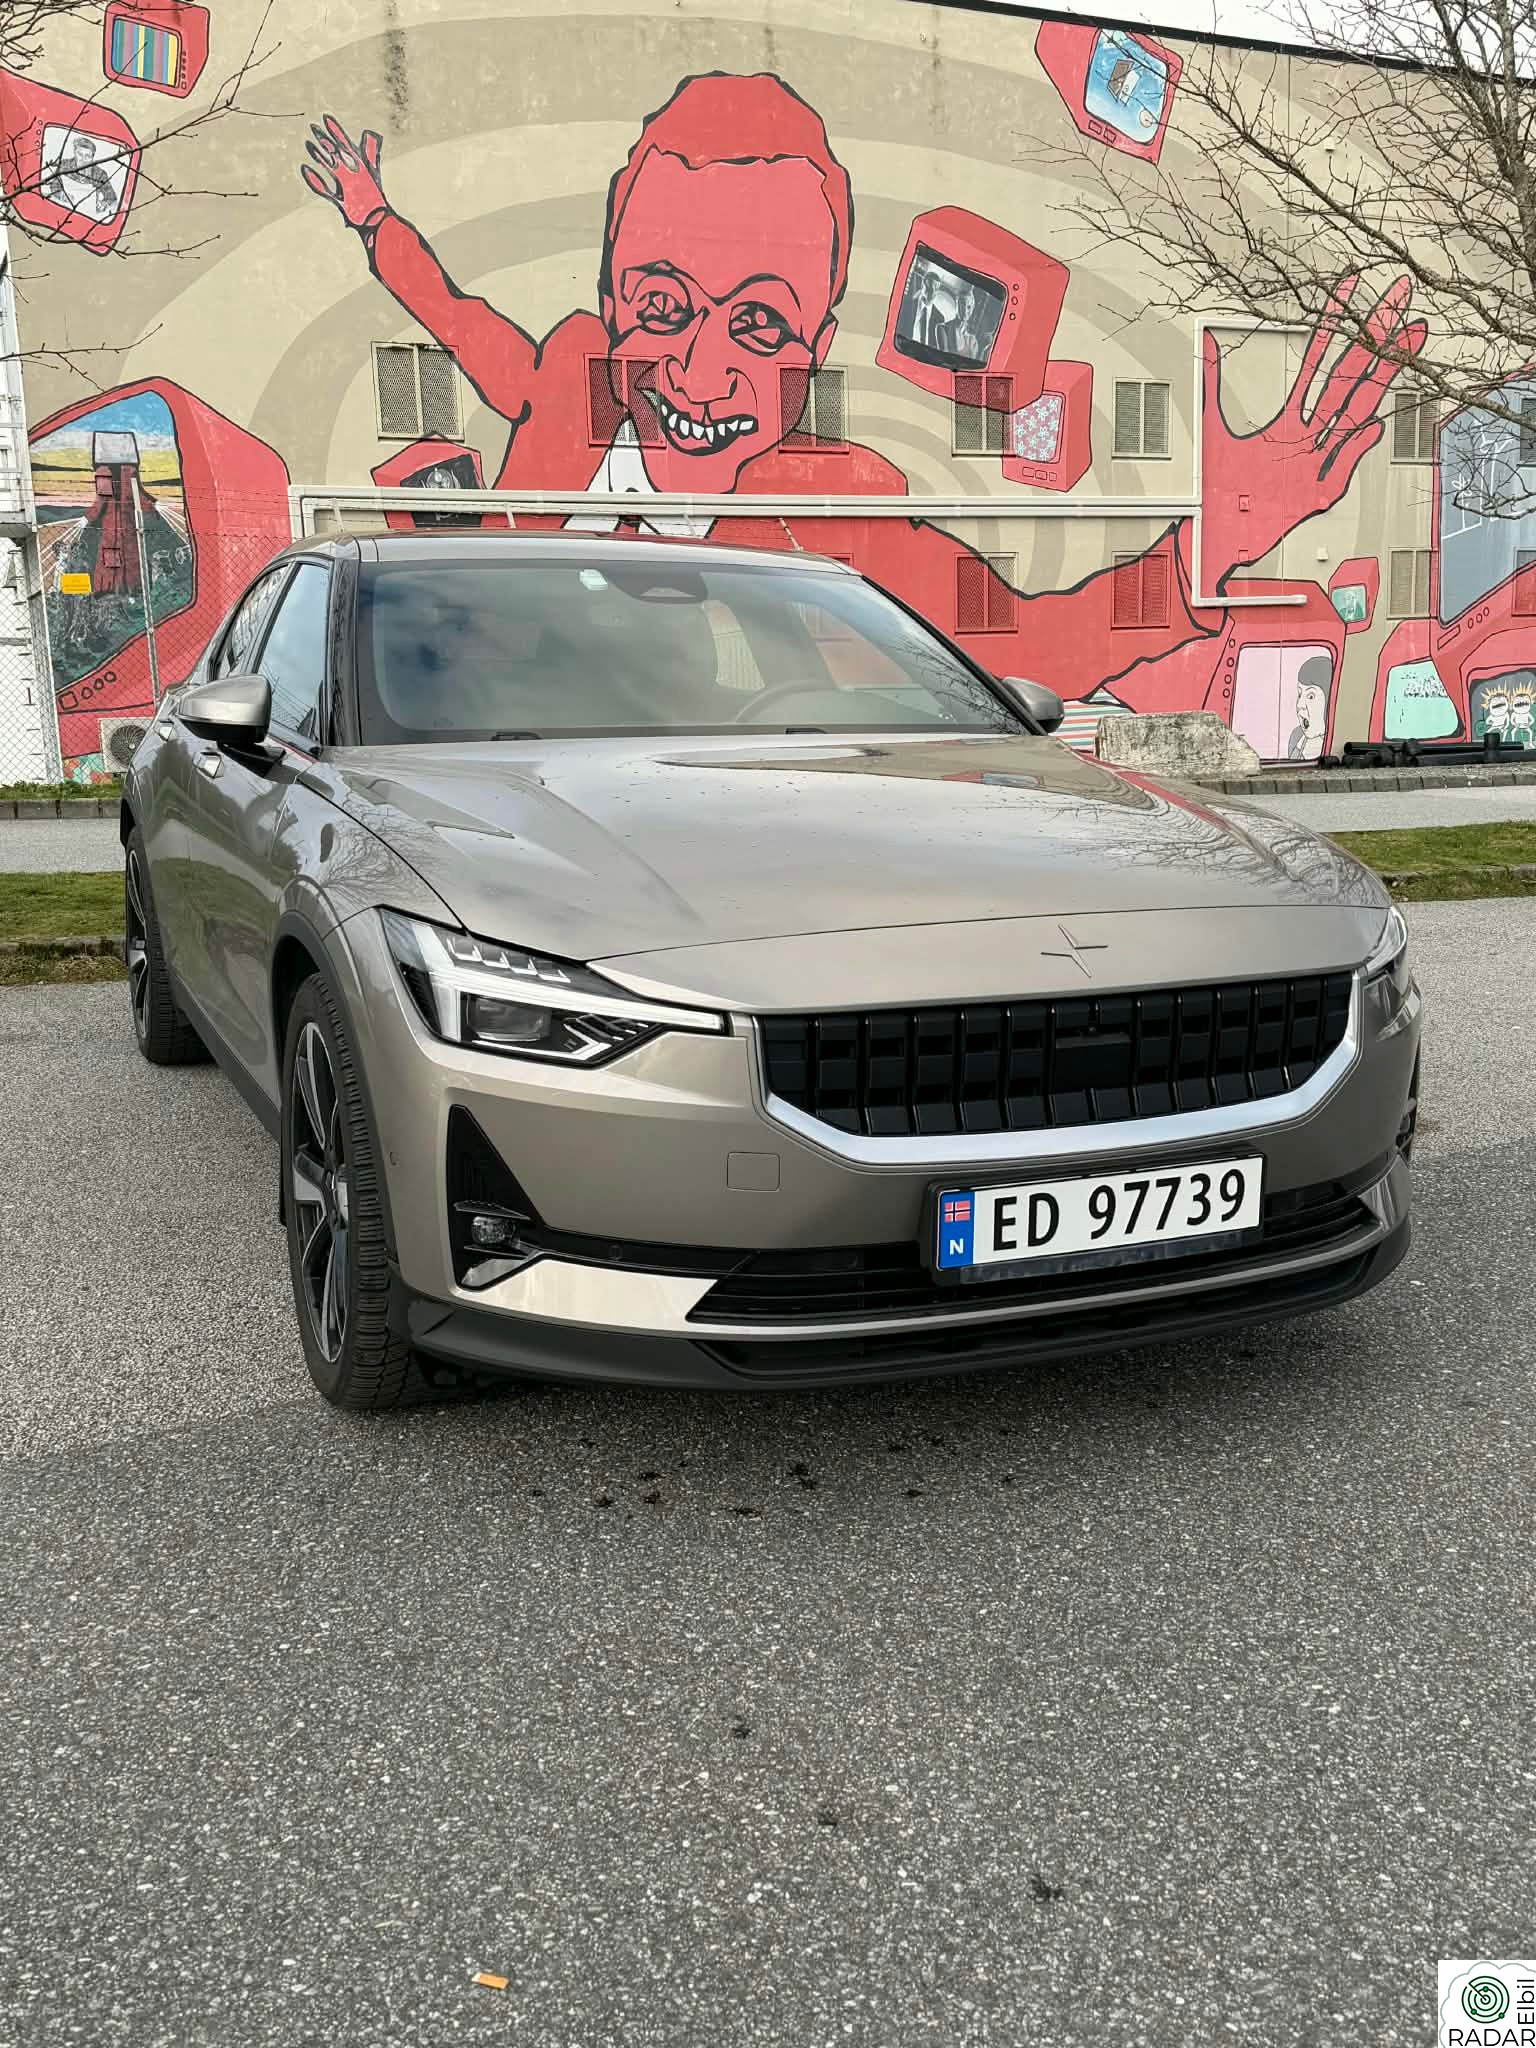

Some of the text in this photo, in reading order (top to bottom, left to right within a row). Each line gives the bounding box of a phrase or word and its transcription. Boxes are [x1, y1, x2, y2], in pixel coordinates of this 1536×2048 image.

[993, 1168, 1246, 1251] ED 97739
[949, 1238, 964, 1255] N
